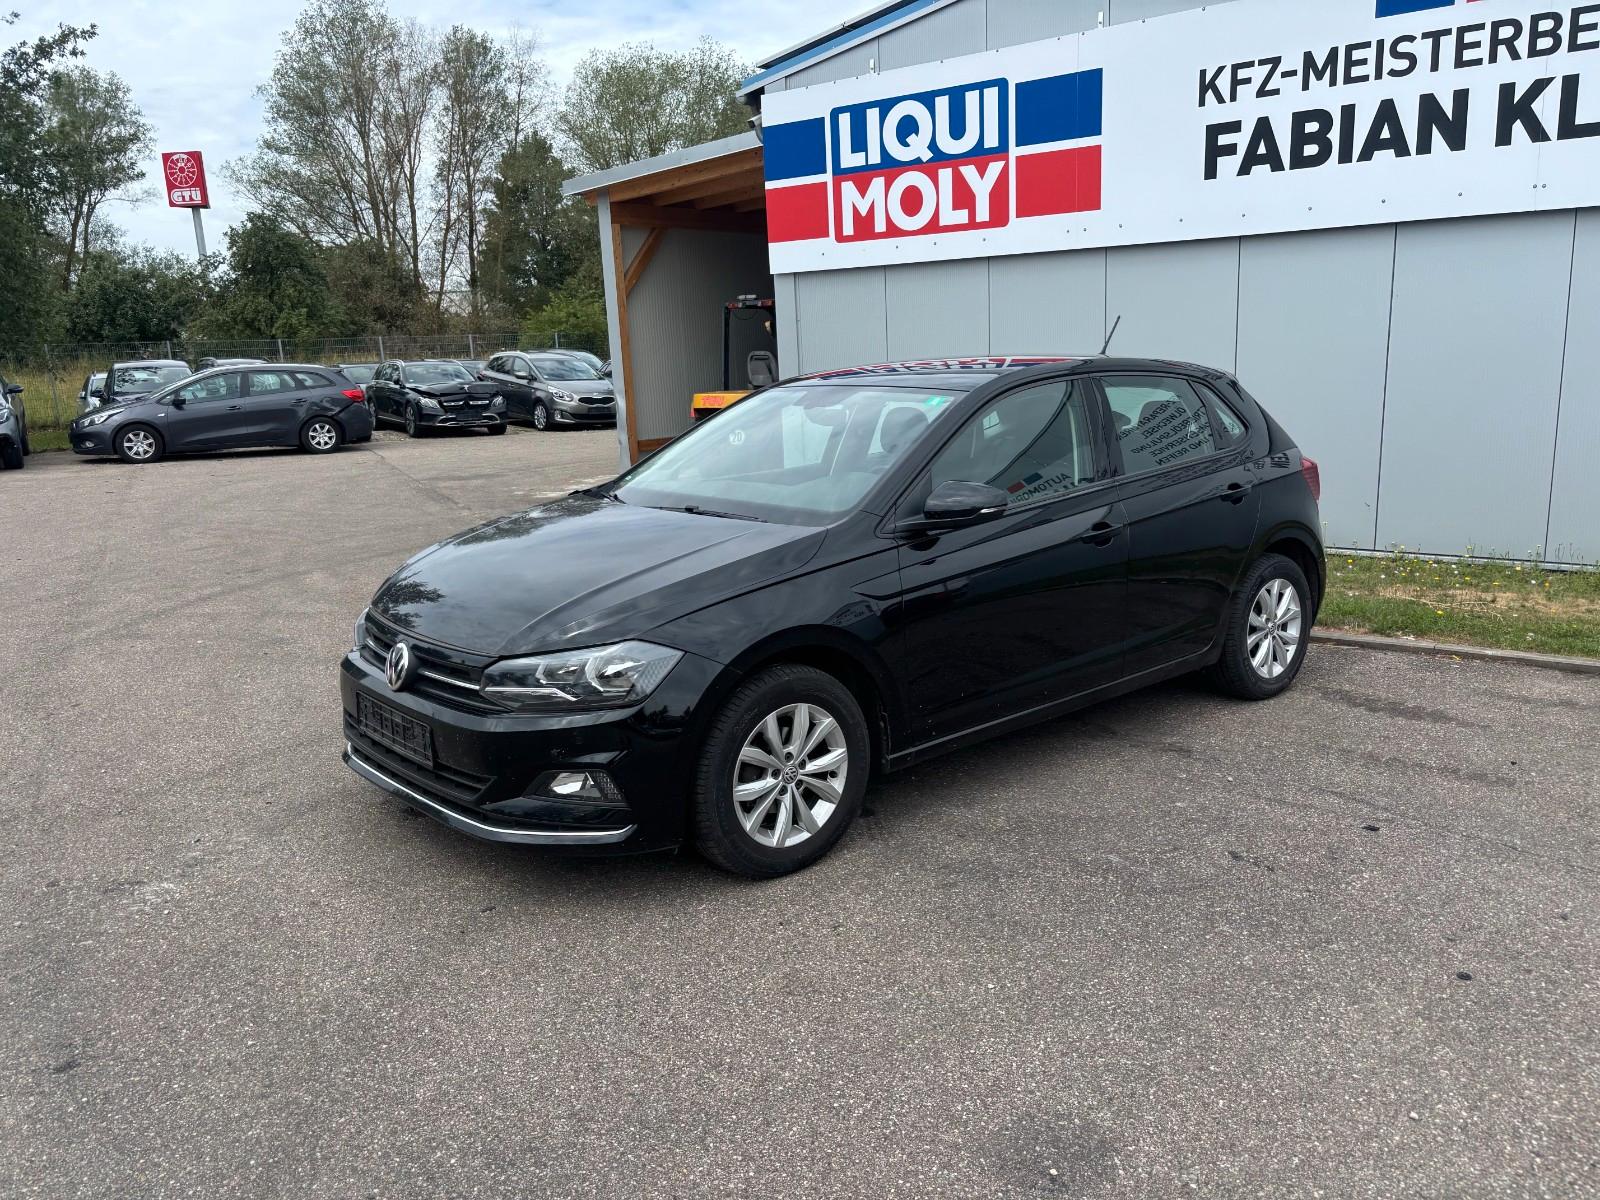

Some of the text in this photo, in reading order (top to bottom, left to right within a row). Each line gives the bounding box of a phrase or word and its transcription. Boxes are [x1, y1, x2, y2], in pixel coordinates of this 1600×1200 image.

[1198, 3, 1600, 108] KFZ-MEISTERBE
[838, 86, 999, 169] LIQUI
[1203, 73, 1600, 180] FABIAN KL
[171, 187, 202, 203] GTÜ
[840, 160, 1006, 236] MOLY
